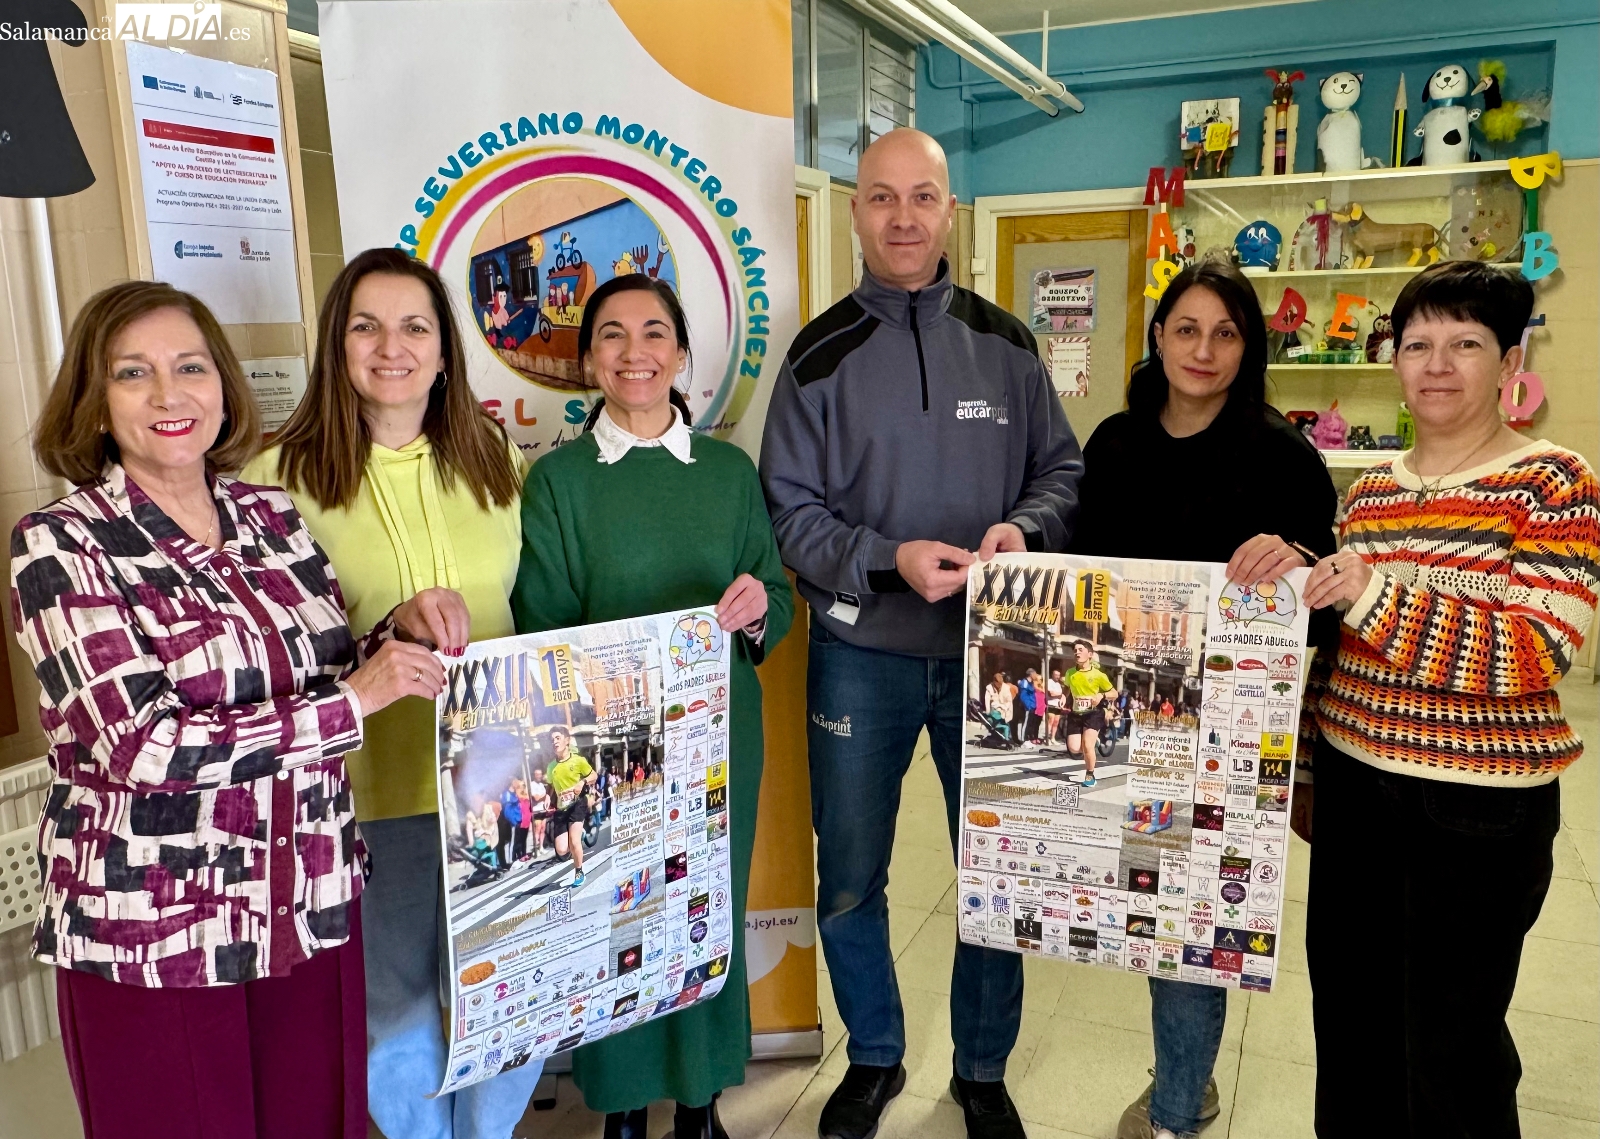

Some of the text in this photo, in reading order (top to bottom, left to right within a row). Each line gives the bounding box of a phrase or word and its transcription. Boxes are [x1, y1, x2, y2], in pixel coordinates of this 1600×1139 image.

[414, 111, 770, 380] SEVERIANO MONTERO SÁNCHEZ
[1269, 287, 1368, 341] DE
[974, 562, 1069, 611] XXXII
[1080, 572, 1108, 610] 1 mayo
[1083, 609, 1103, 621] 2026
[1233, 633, 1263, 646] PADRES
[1264, 635, 1299, 648] ABUELOS
[541, 648, 571, 691] 1 mayo
[443, 651, 528, 718] XXXII
[684, 674, 706, 690] PADRES
[552, 689, 573, 704] 2026
[1234, 688, 1265, 698] CASTILLO
[1230, 739, 1260, 750] Kiosko
[1232, 758, 1254, 773] LB
